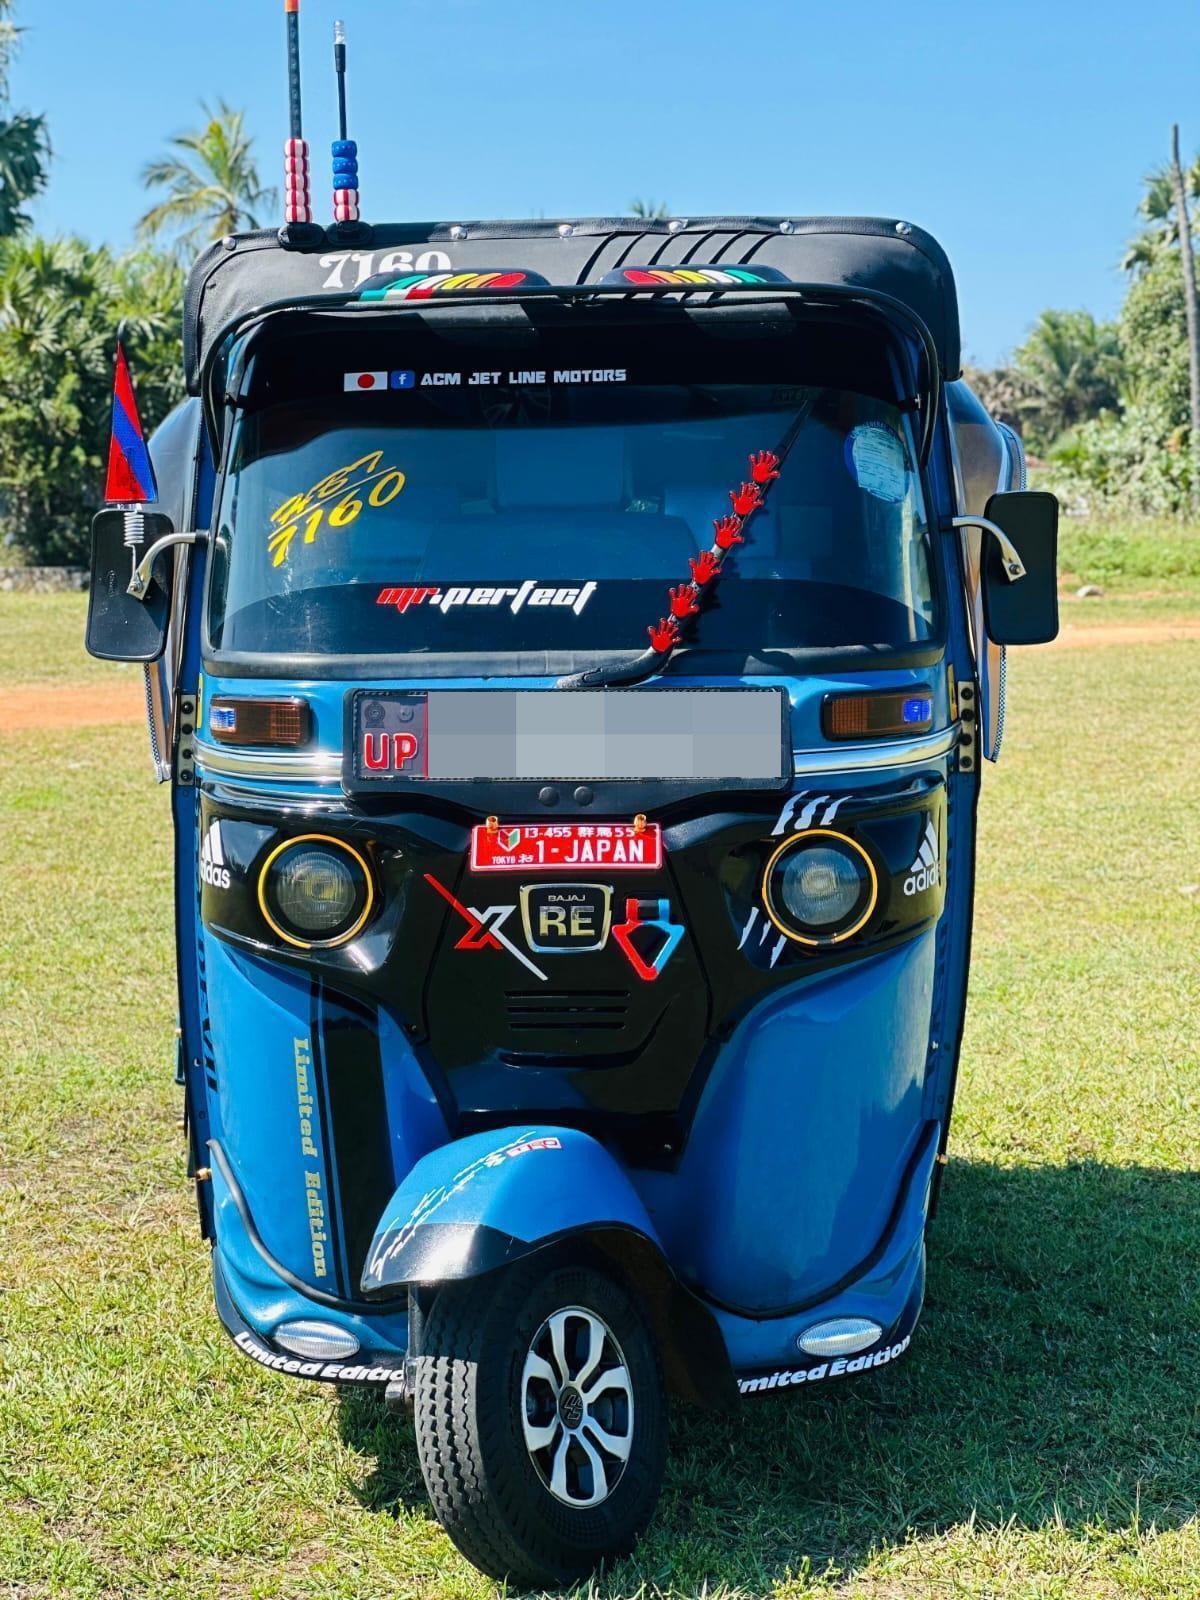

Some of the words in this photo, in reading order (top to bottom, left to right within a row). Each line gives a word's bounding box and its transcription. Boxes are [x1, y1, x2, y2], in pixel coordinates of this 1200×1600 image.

[319, 251, 452, 289] 7160
[420, 373, 461, 386] ACM
[468, 372, 502, 385] JET
[508, 371, 546, 384] LINE
[553, 369, 627, 383] MOTORS
[268, 471, 406, 568] 7160
[364, 732, 418, 770] UP
[548, 895, 586, 903] BAJAJ
[539, 905, 595, 937] RE
[294, 1037, 318, 1157] Limited
[305, 1170, 327, 1278] Edition
[234, 1331, 324, 1376] Limited
[320, 1364, 404, 1381] Editio
[829, 1334, 911, 1377] Edition
